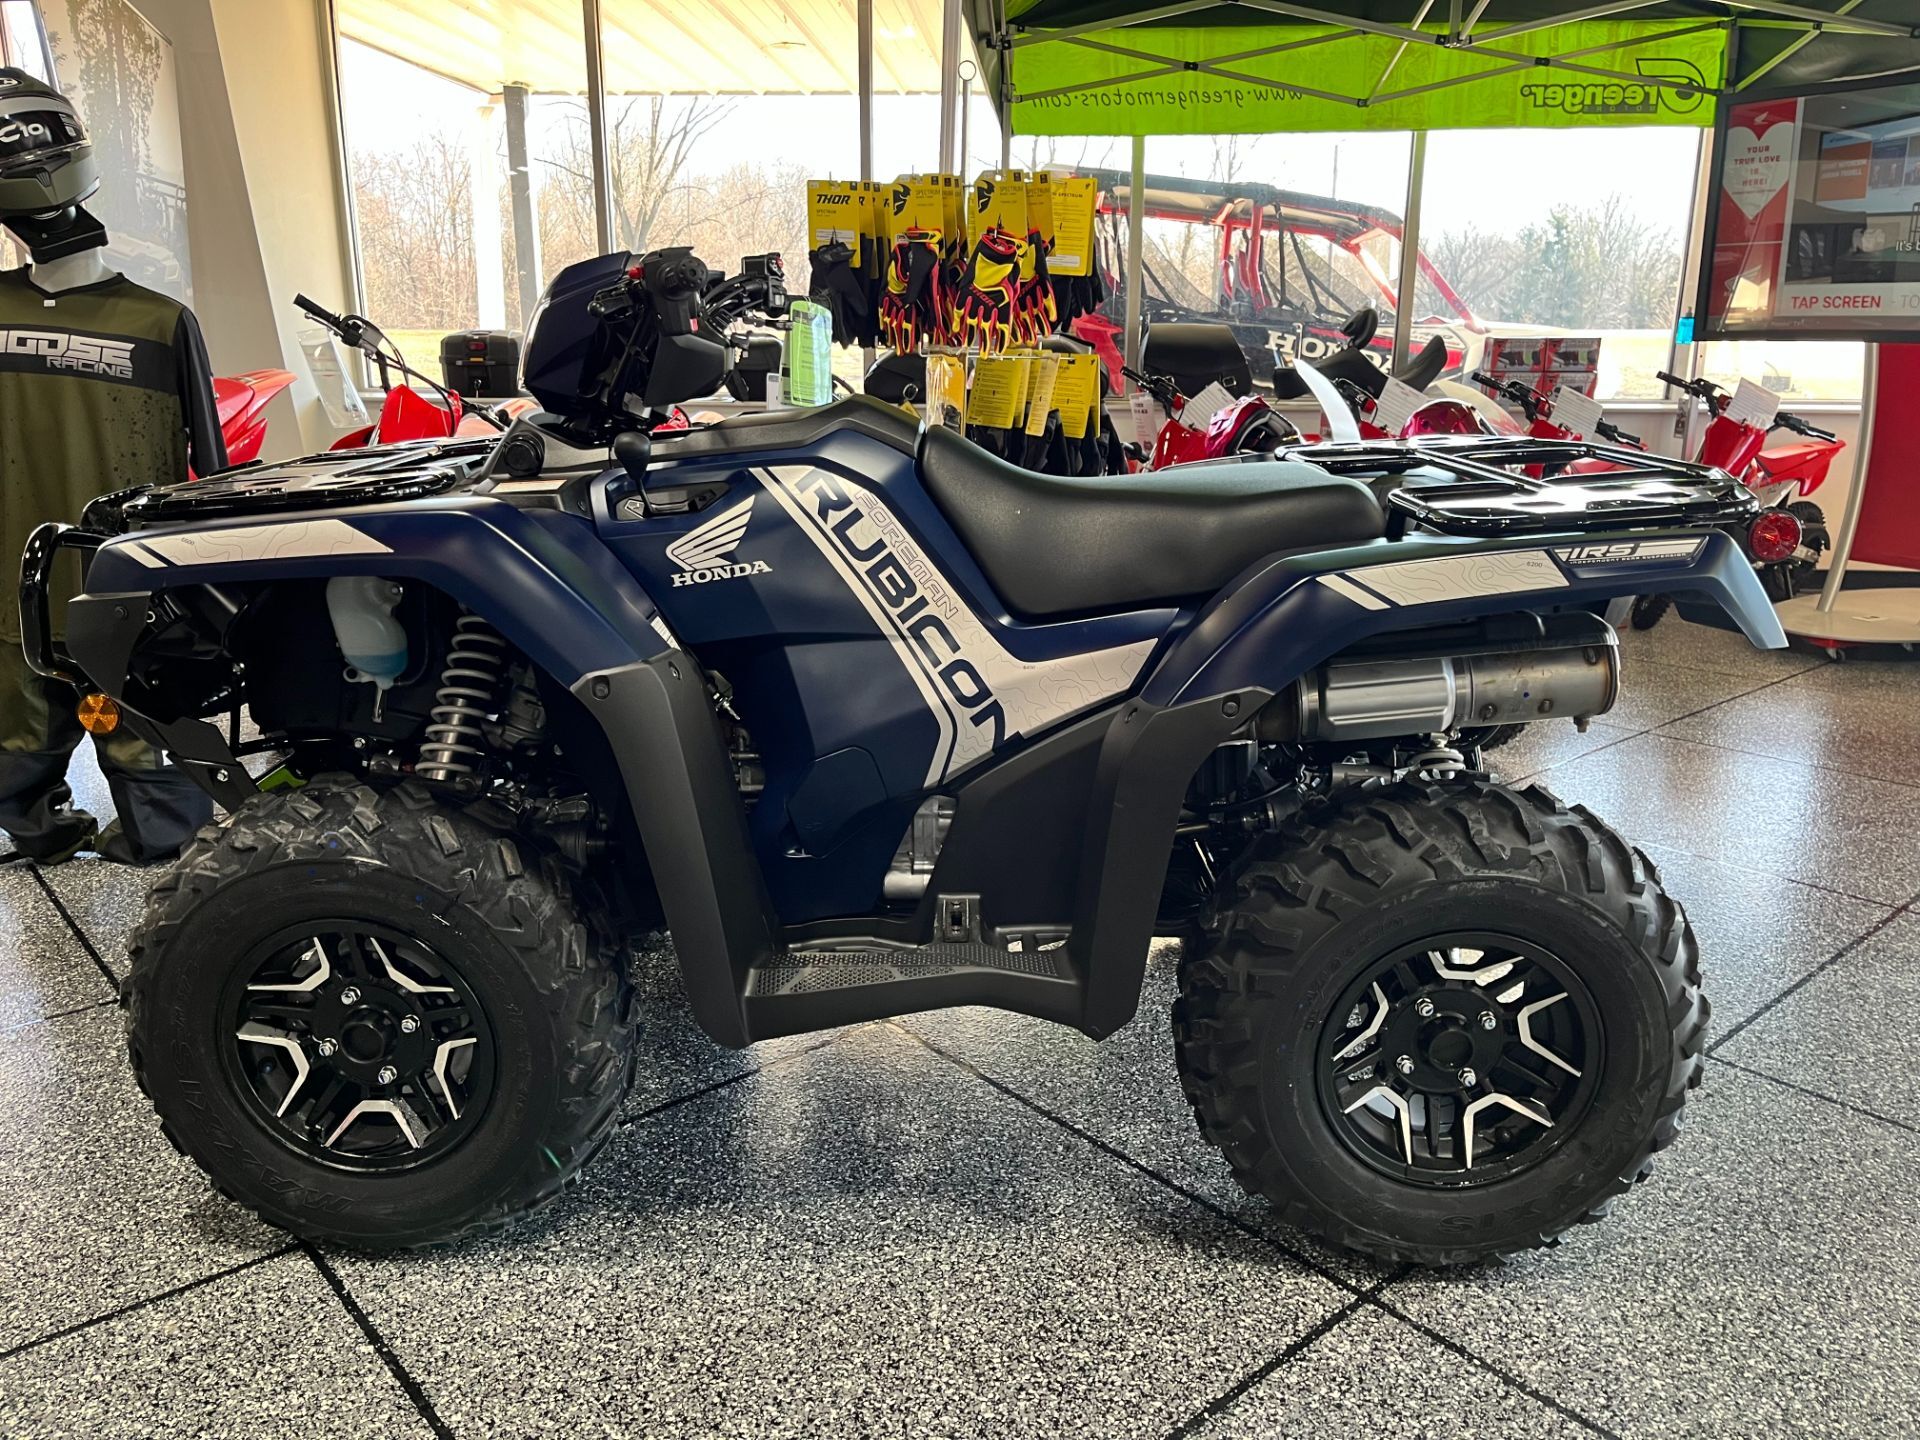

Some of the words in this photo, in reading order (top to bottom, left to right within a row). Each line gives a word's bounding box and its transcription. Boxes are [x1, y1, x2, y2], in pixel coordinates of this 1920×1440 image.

[1747, 145, 1770, 154] YOUR
[1734, 158, 1756, 166] TRUE
[1758, 155, 1781, 164] LOVE
[816, 194, 851, 205] THOR
[1792, 296, 1818, 309] TAP
[1823, 295, 1881, 309] SCREEN
[0, 330, 136, 368] OOSE
[46, 356, 133, 380] RACING
[854, 489, 959, 620] FOREMAN
[1568, 543, 1635, 560] IRS
[1569, 557, 1620, 565] INDEPENDENT
[1642, 552, 1687, 560] SUSPENSION
[670, 560, 773, 588] HONDA
